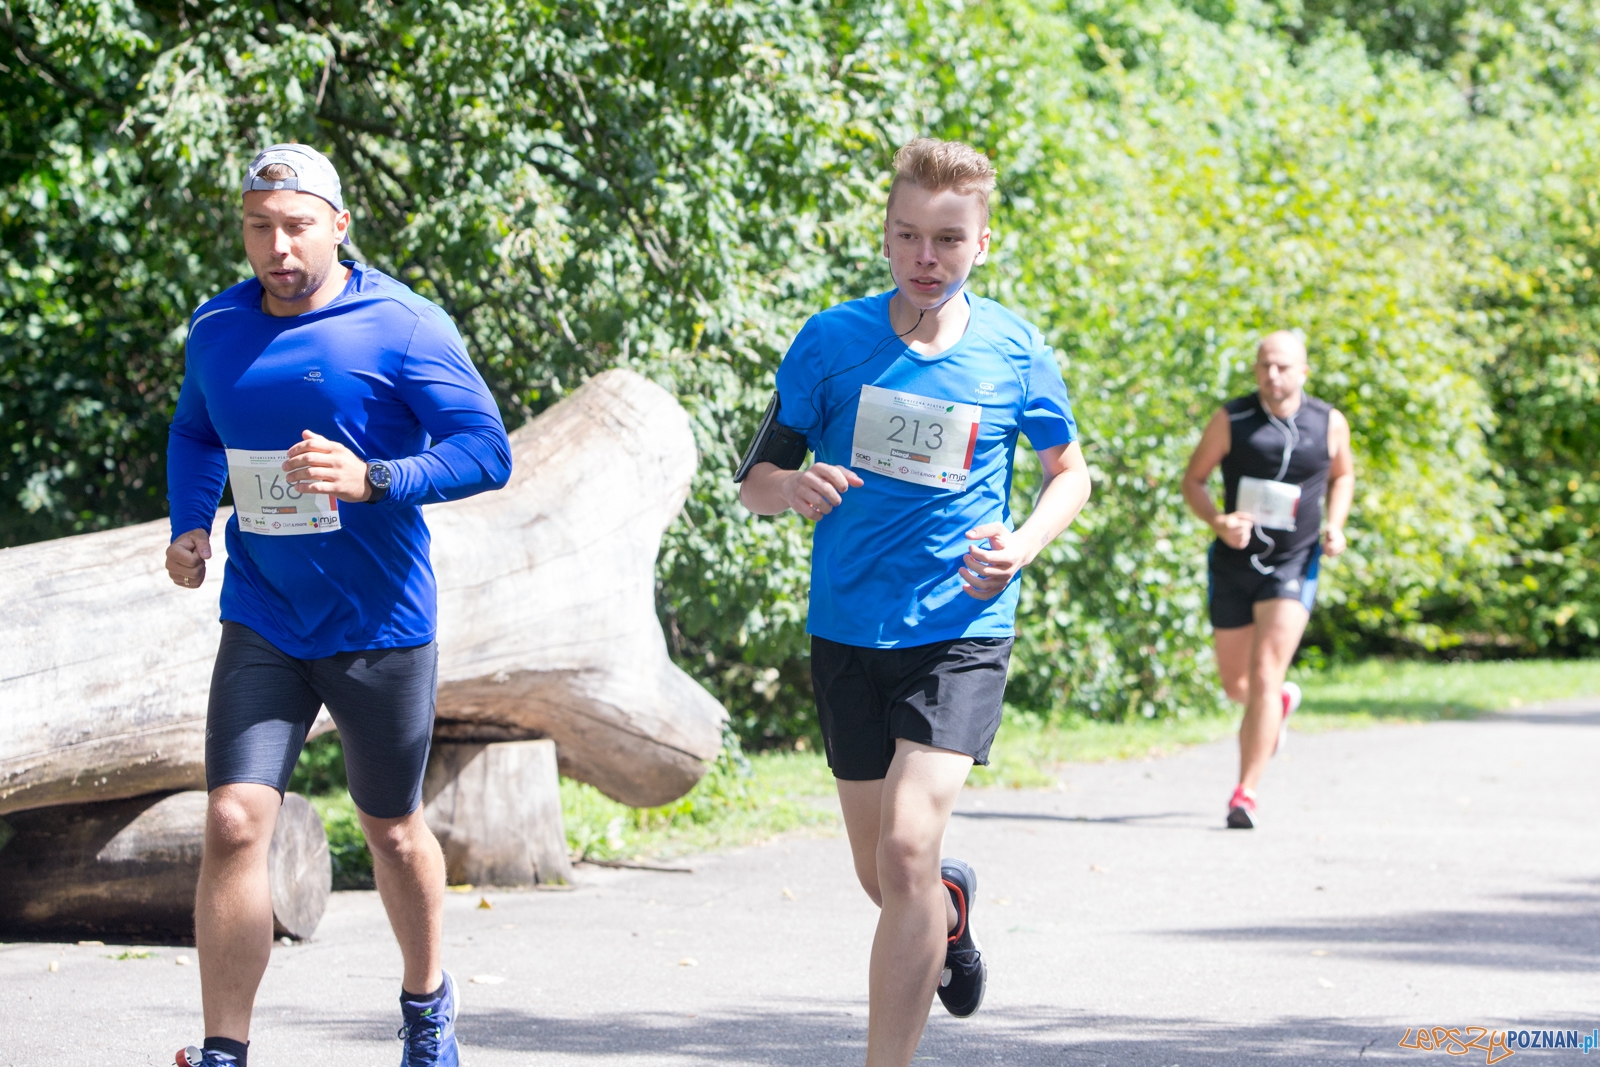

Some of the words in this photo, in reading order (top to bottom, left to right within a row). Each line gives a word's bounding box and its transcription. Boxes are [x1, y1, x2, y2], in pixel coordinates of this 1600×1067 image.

[886, 415, 944, 450] 213
[949, 473, 967, 482] mjp
[320, 515, 338, 525] mjp
